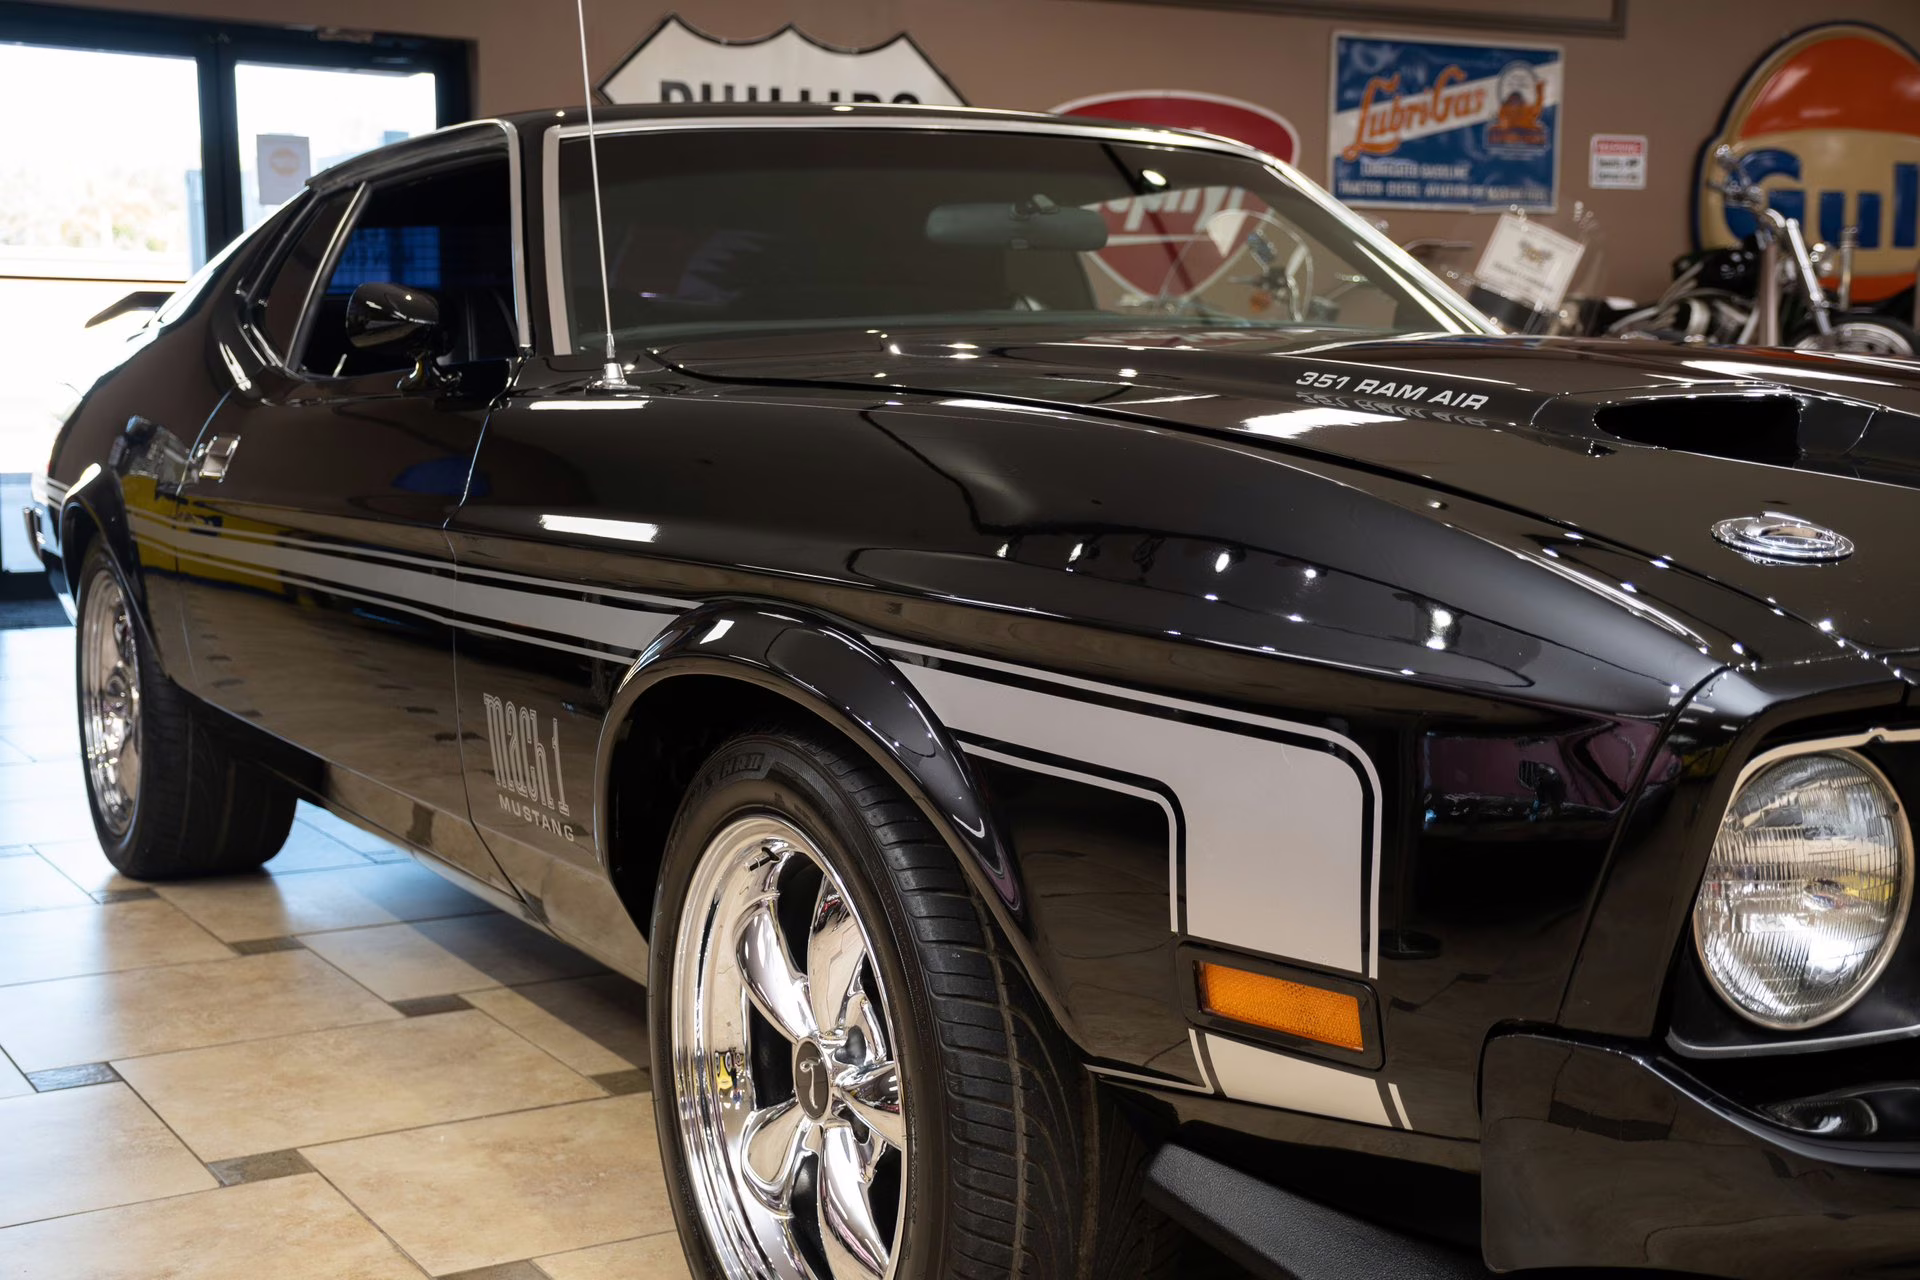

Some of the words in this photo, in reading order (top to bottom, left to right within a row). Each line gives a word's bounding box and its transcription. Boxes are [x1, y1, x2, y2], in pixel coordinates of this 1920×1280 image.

[1296, 371, 1350, 390] 351
[1353, 378, 1428, 401] RAM
[1428, 390, 1489, 410] AIR
[498, 794, 574, 842] MUSTANG
